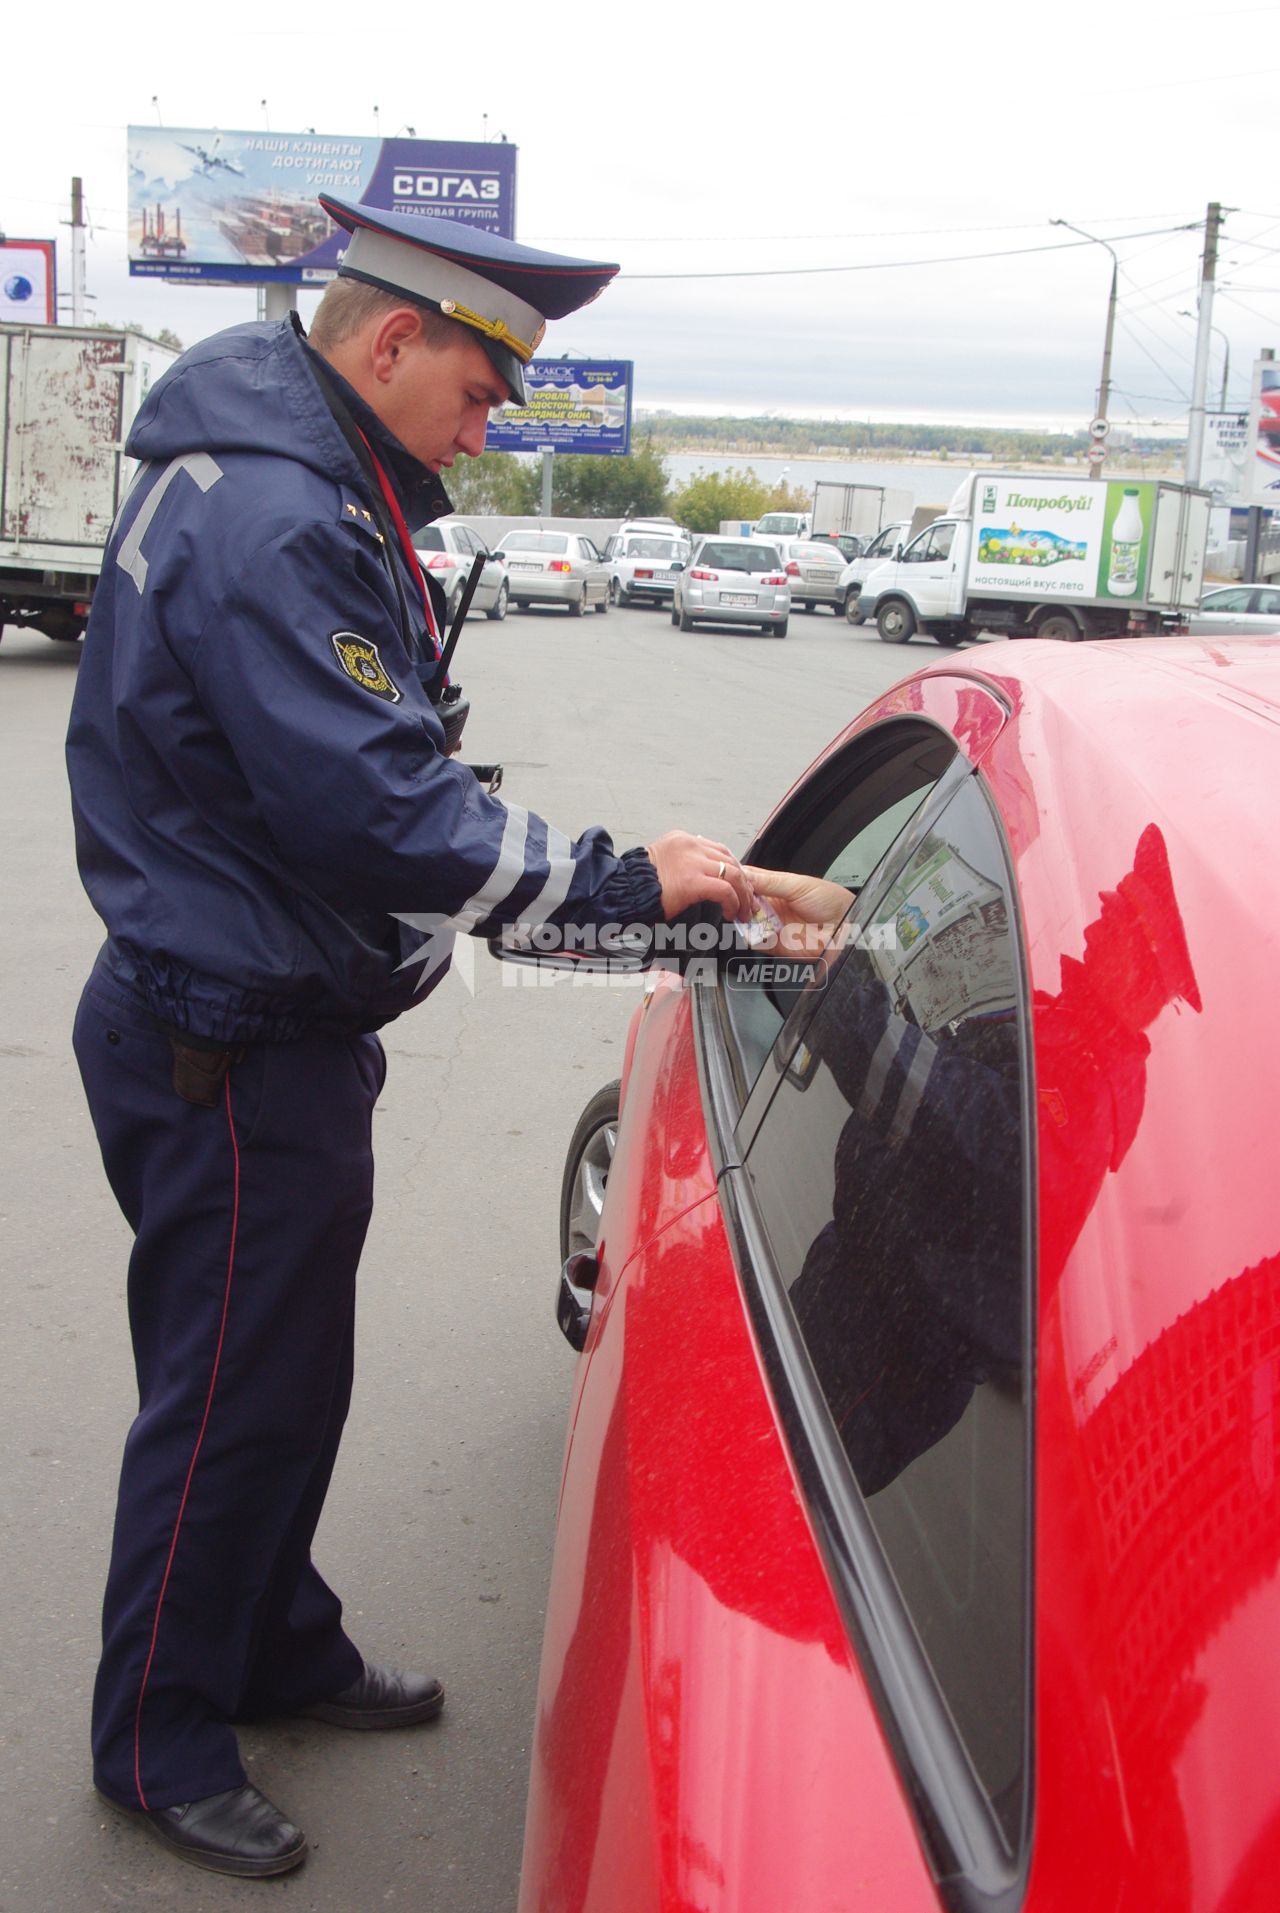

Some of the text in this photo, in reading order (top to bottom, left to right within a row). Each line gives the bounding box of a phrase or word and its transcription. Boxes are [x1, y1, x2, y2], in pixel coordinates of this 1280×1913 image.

[247, 139, 363, 156] НАШИ КЛИЕНТЫ
[272, 155, 362, 172] ДОСТИГАЮТ
[305, 172, 361, 187] УСПЕХА
[392, 174, 500, 200] СОГАЗ
[392, 204, 499, 219] СТРАХОВАЯ ГРУППА
[536, 366, 575, 377] САКСЭС
[534, 391, 569, 400] КРОВЛЯ
[505, 409, 591, 419] МАНСАРДНЫЕ ОКНА
[1006, 493, 1092, 512] Попробуй!
[975, 576, 1032, 589] настоящий
[1033, 579, 1057, 591] вкус
